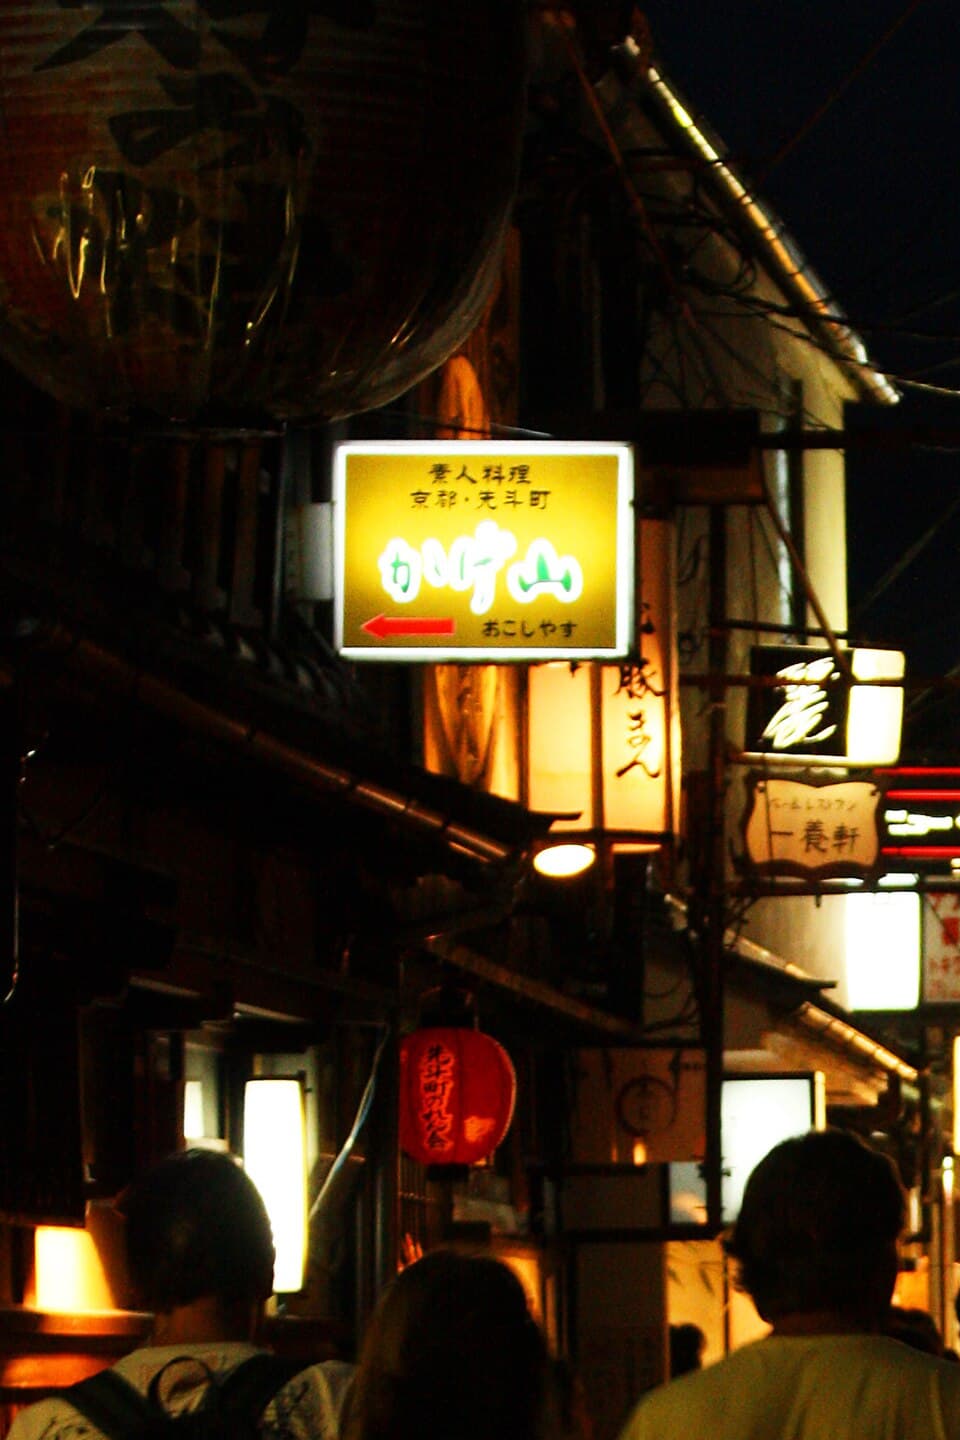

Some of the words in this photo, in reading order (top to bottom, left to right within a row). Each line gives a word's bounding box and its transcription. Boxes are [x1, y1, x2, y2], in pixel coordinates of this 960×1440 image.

[428, 463, 532, 485] 素人料理
[380, 521, 582, 614] かげ山
[482, 618, 577, 638] おこしやす
